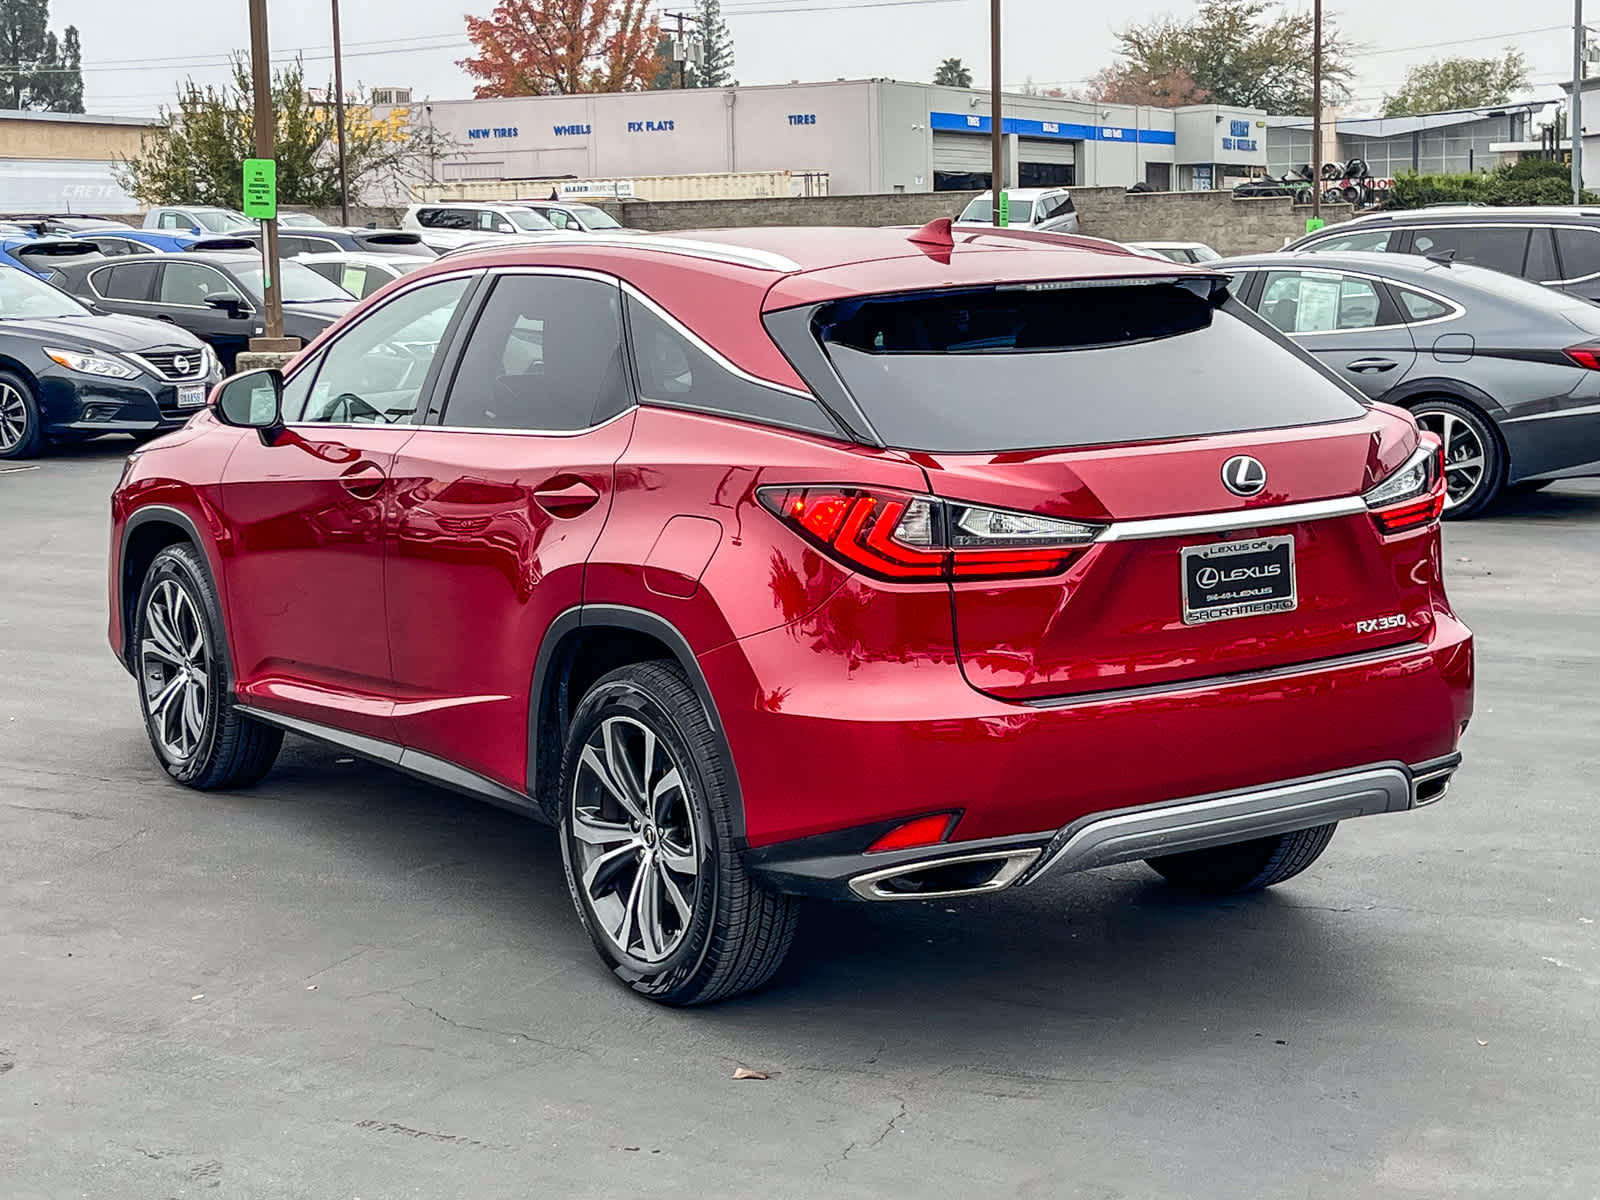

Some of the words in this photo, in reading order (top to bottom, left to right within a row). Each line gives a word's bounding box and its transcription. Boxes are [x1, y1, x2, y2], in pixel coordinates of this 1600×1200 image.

[787, 113, 817, 126] TIRES
[553, 124, 592, 136] WHEELS
[627, 121, 643, 133] FIX
[646, 120, 675, 132] FLATS
[468, 128, 491, 140] NEW
[493, 127, 519, 138] TIRES
[1209, 543, 1250, 555] LEXUS
[1251, 541, 1268, 550] OF
[1220, 563, 1281, 582] LEXUS
[1188, 600, 1294, 621] SACRAMENTO
